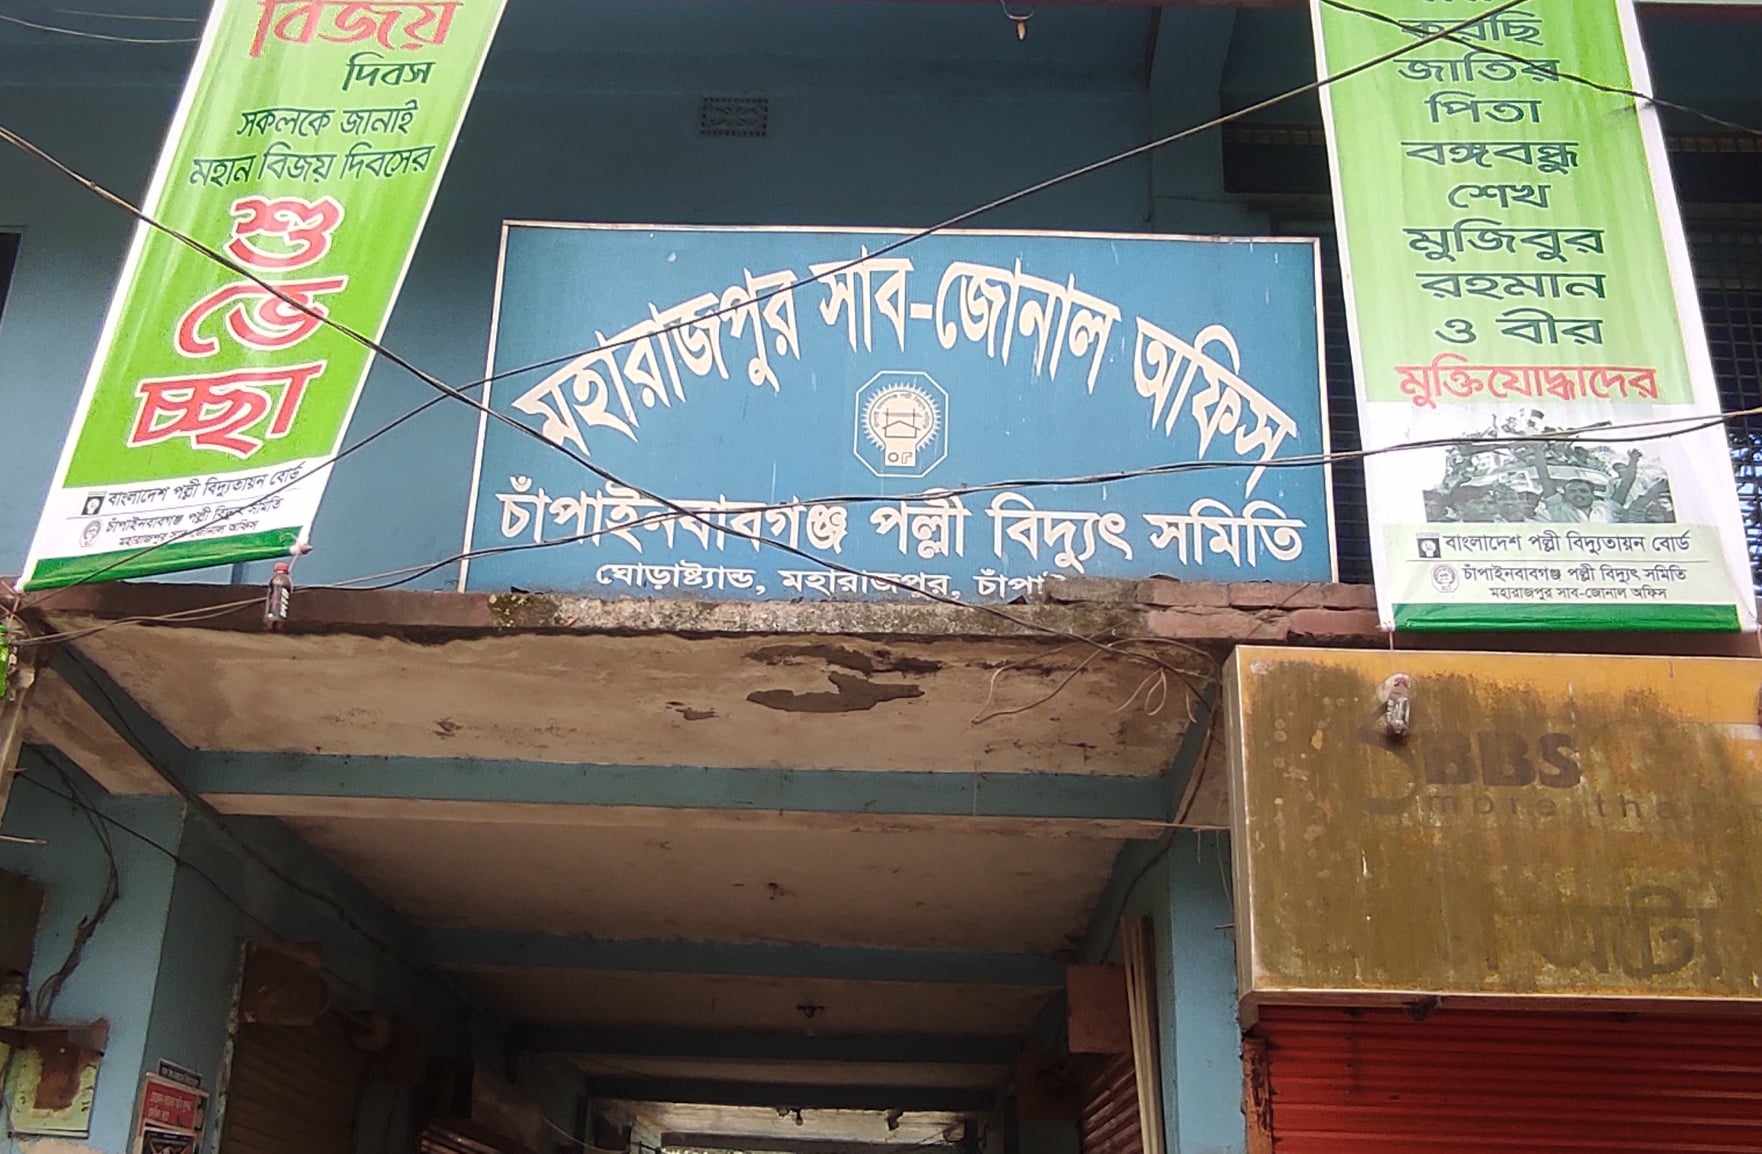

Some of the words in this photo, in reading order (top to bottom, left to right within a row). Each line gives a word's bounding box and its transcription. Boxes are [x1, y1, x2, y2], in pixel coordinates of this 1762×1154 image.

[342, 52, 436, 91] দিবস
[1393, 50, 1560, 82] জাতির
[236, 108, 336, 137] সকলকে
[340, 99, 419, 136] জানাই
[1424, 90, 1542, 124] পিতা
[189, 154, 257, 188] মহান
[257, 141, 337, 183] বিজয়
[339, 142, 436, 180] দিবসের
[1401, 142, 1580, 175] বঙ্গবন্ধু
[1447, 184, 1551, 209] শেখ
[1403, 217, 1605, 263] মুজিবুর
[1416, 272, 1606, 300] রহমান
[177, 277, 347, 356] ভে
[1435, 317, 1478, 345] ও
[1496, 307, 1603, 346] বীর
[511, 267, 801, 457] মহারাজপুর
[808, 244, 1121, 395] সাব-জোনাল
[1132, 315, 1298, 499] অফিস
[1394, 353, 1659, 410] মুক্তিযোদ্ধাদের
[107, 486, 170, 507] বাংলাদেশ
[496, 475, 849, 554] চাঁপাইনবাবগঞ্জ
[870, 487, 971, 560] পল্লী
[985, 491, 1133, 575] বিদ্যুৎ
[1143, 498, 1307, 568] সমিতি
[1443, 534, 1522, 552] বাংলাদেশ
[1528, 530, 1562, 553] পল্লী
[1567, 531, 1645, 556] বিদ্যুতায়ন
[1651, 529, 1692, 552] বোর্ড
[1462, 563, 1562, 583] চাঁপাইনবাবগঞ্জ
[1567, 562, 1596, 583] পল্লী
[1643, 563, 1688, 582] সমিতি
[1423, 731, 1584, 788] BBS
